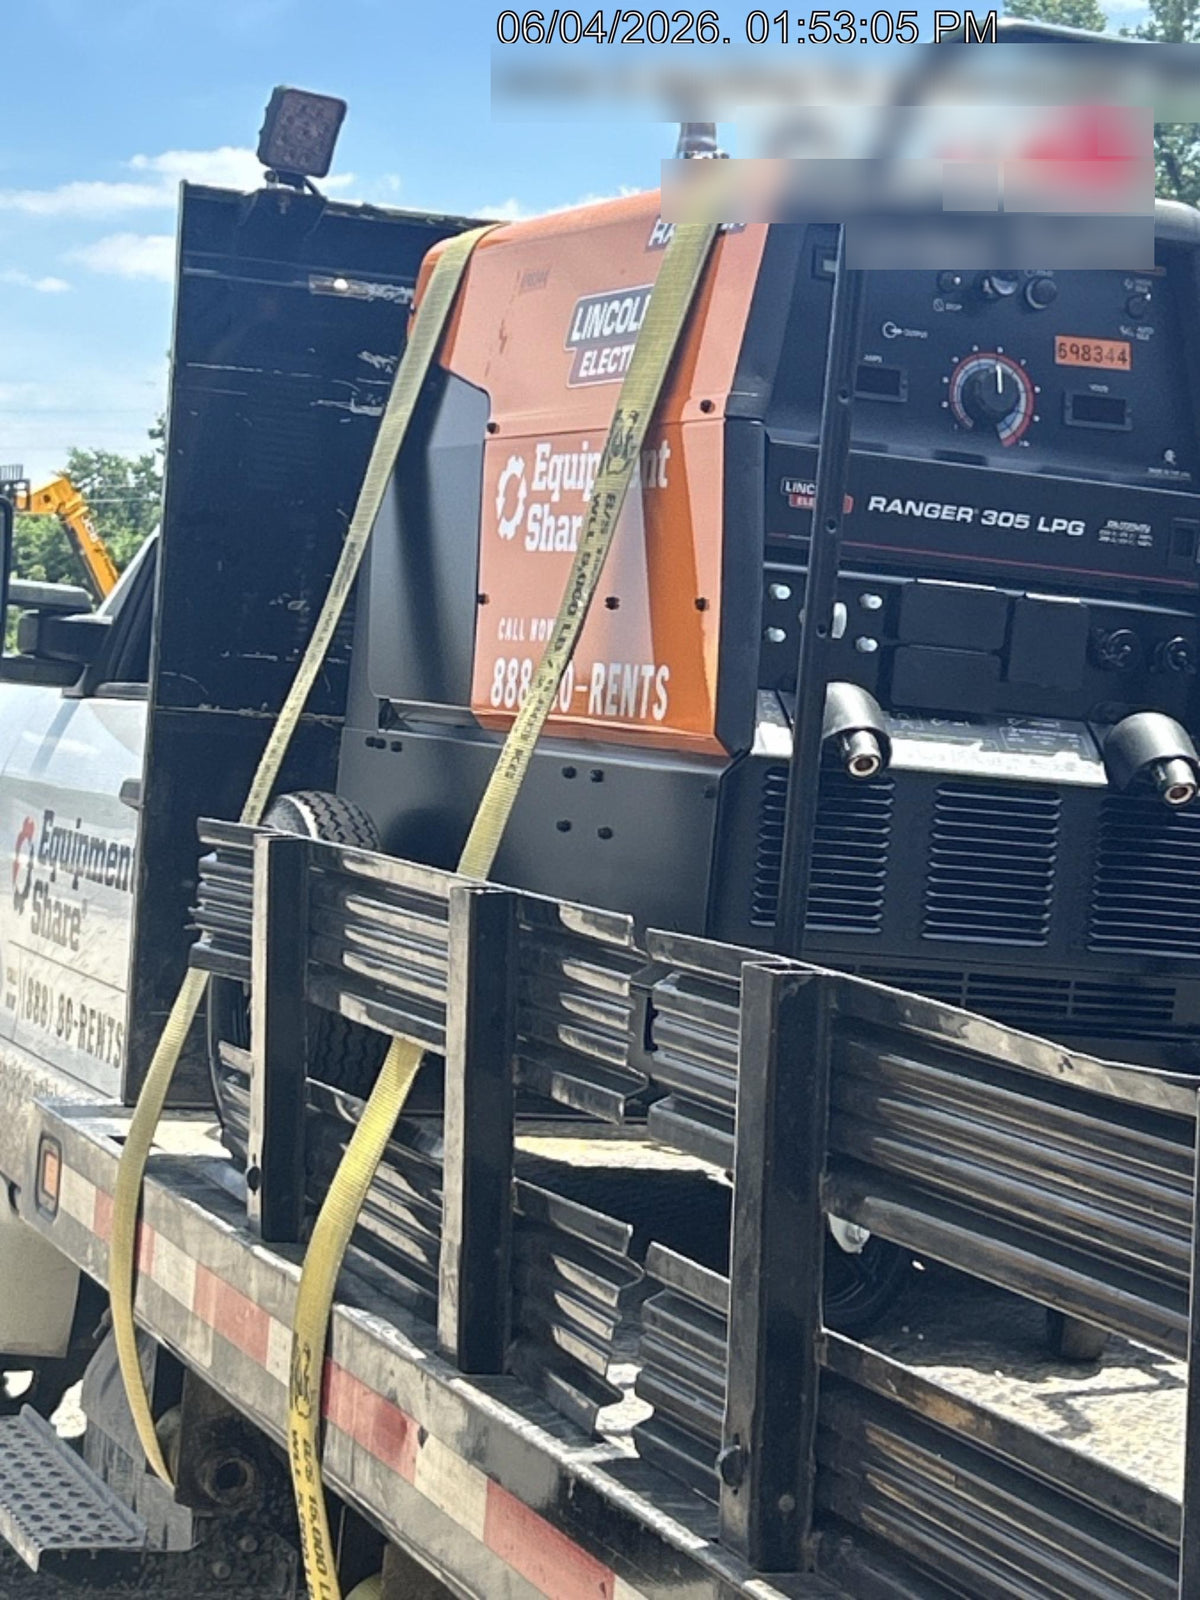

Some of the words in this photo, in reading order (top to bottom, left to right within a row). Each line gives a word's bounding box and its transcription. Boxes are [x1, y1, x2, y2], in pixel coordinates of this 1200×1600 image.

[569, 294, 652, 342] LINCOL
[578, 344, 636, 378] ELECT
[1058, 342, 1128, 366] 698344
[531, 440, 671, 502] Equipnt
[785, 481, 816, 495] LINC
[525, 502, 581, 553] Shar
[867, 495, 973, 524] RANGER
[981, 509, 1030, 530] 305
[1037, 516, 1085, 537] LPG
[498, 617, 525, 642] CALL
[38, 809, 136, 894] Equipmen
